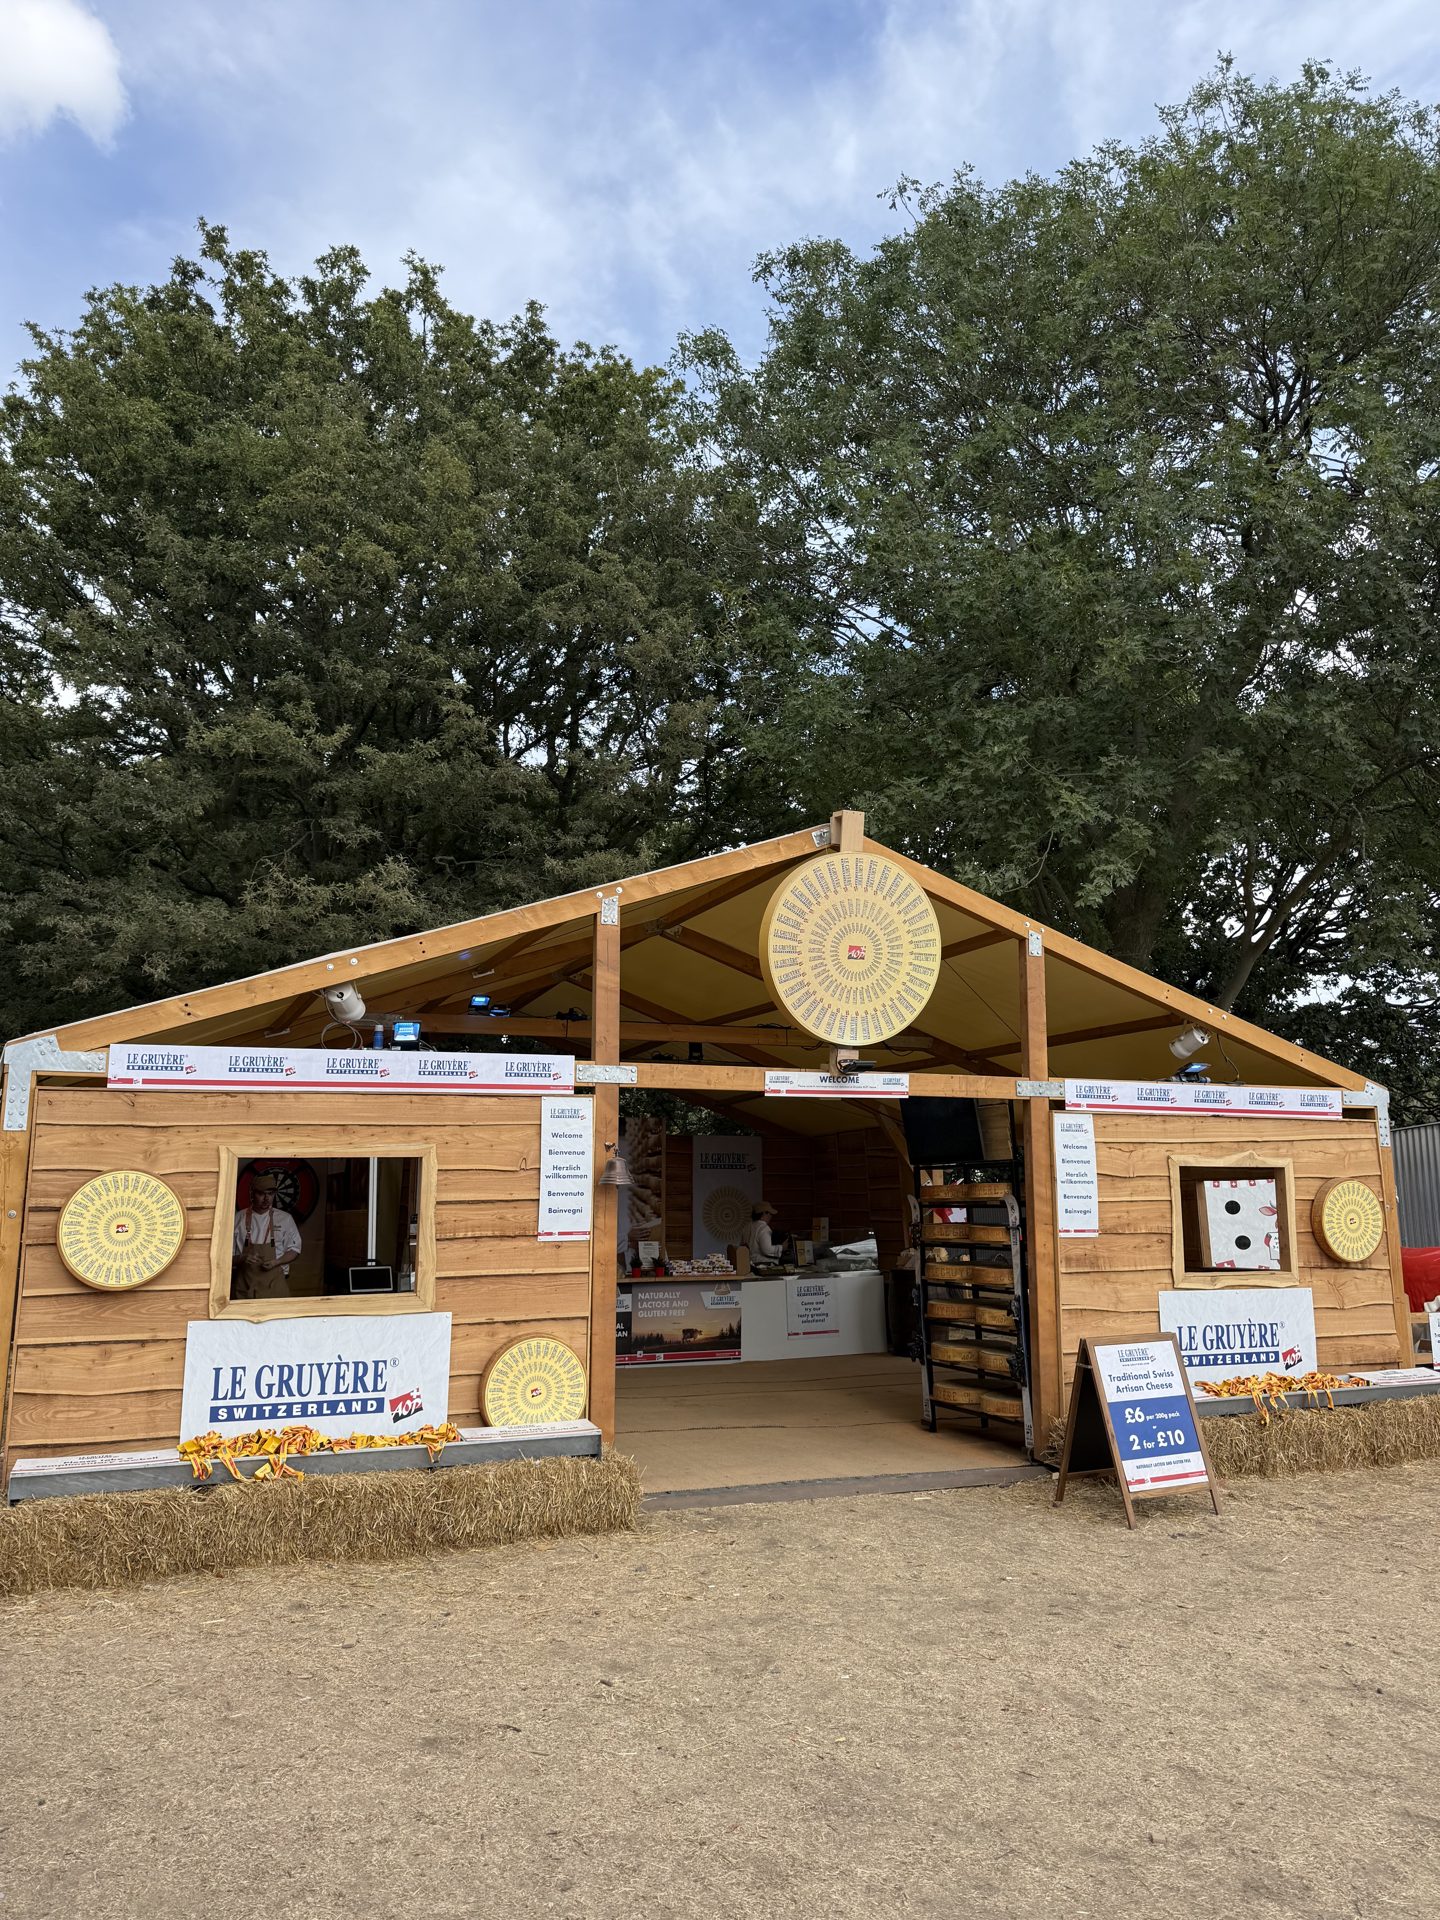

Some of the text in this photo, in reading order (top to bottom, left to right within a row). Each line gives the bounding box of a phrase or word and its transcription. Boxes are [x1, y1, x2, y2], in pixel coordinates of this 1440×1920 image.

[128, 1053, 138, 1064] LE
[229, 1056, 240, 1066] LE
[327, 1058, 337, 1068] LE
[419, 1060, 428, 1069] LE
[505, 1062, 514, 1071] LE
[820, 1076, 859, 1084] WELCOME
[1076, 1085, 1083, 1093] LE
[1137, 1088, 1144, 1096] LE
[1194, 1090, 1201, 1098] LE
[1249, 1092, 1255, 1100] LE
[548, 1207, 583, 1215] Bainvegni
[638, 1301, 670, 1309] LACTOSE
[638, 1310, 666, 1318] GLUTEN
[1177, 1326, 1198, 1351] LE
[1184, 1352, 1275, 1366] SWITZERLAND
[1108, 1369, 1174, 1382] Traditional Swiss
[211, 1366, 247, 1401] LE
[1116, 1381, 1173, 1393] Artisan Cheese
[218, 1400, 378, 1420] SWITZERLAND
[1125, 1407, 1145, 1423] £6
[1168, 1411, 1180, 1419] pack
[1129, 1429, 1185, 1450] 2 for £10
